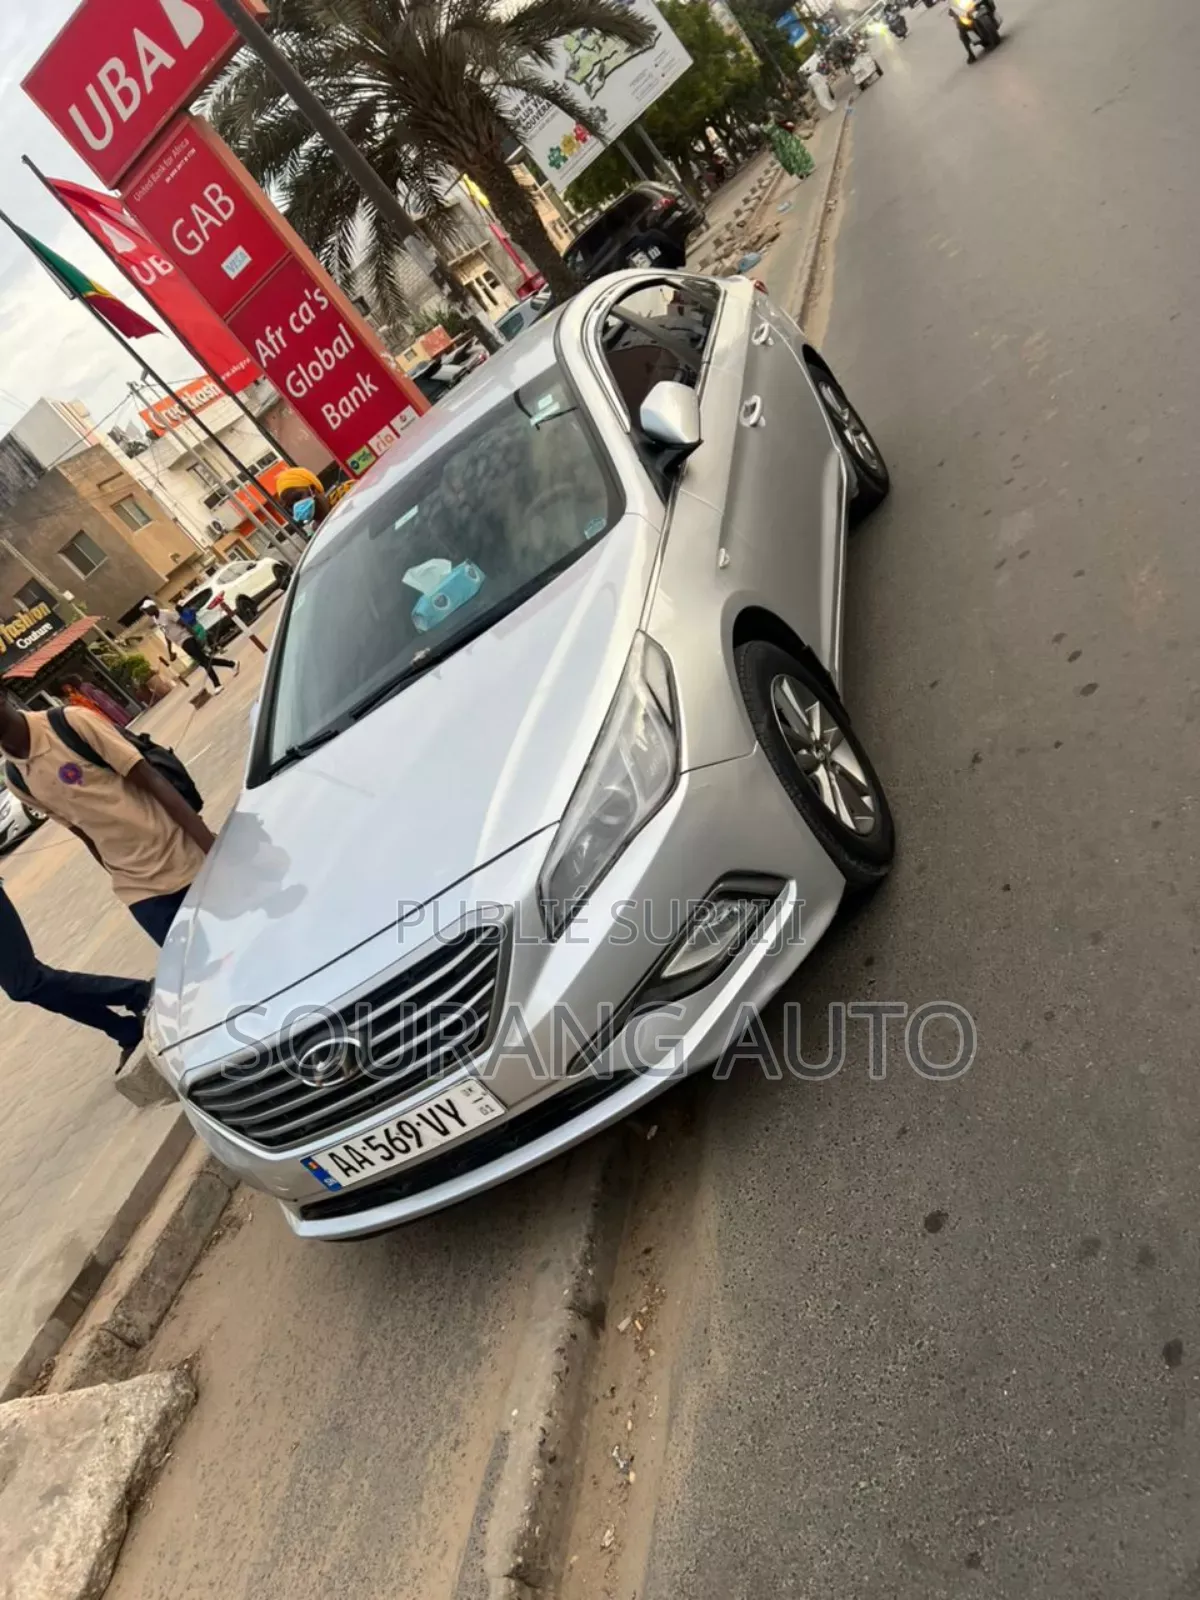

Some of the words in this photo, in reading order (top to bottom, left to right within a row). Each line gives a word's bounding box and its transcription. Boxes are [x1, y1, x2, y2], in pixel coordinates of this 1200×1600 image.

[68, 27, 176, 151] UBA
[134, 178, 153, 201] United
[151, 164, 167, 184] Bank
[171, 138, 190, 158] Africa
[172, 183, 235, 256] GAB
[130, 255, 174, 285] UB
[285, 323, 355, 398] Global
[321, 372, 379, 431] Bank
[16, 622, 54, 649] Couture
